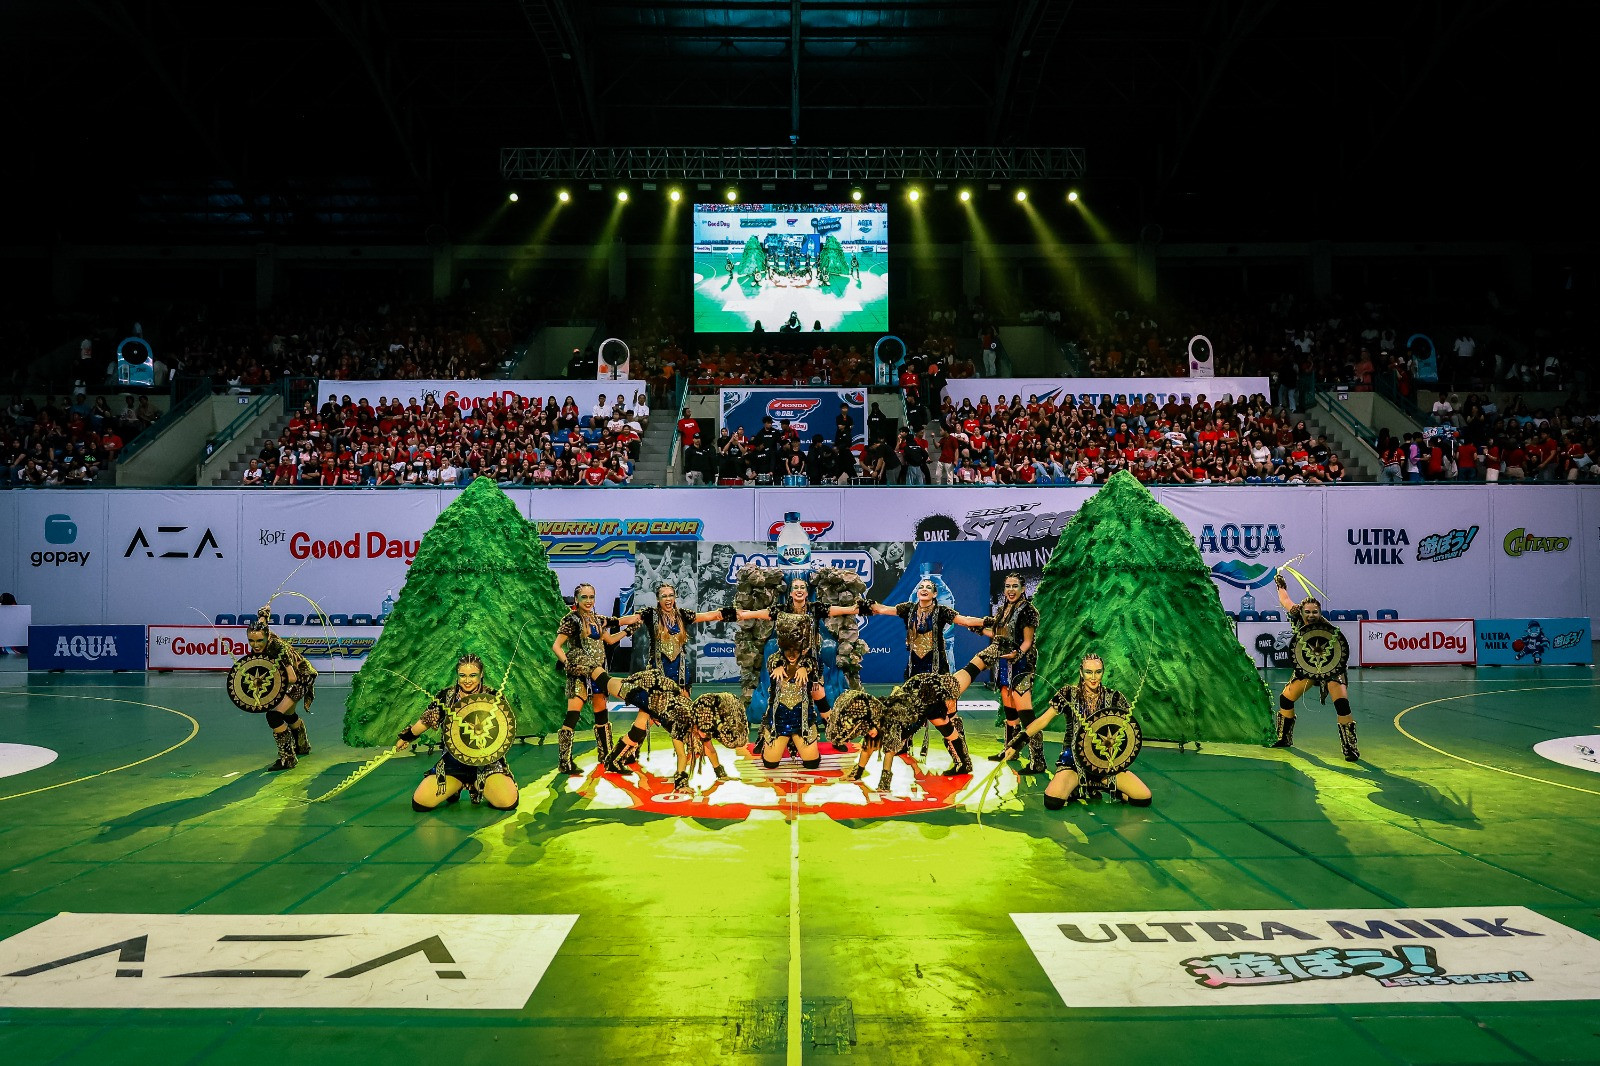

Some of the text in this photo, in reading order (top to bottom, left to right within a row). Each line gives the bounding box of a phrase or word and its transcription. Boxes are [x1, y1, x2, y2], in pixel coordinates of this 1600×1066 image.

[537, 521, 599, 535] WORTH
[627, 521, 649, 535] YA
[650, 521, 699, 535] CUMA
[923, 529, 950, 542] PAKE
[259, 529, 286, 545] Kopi
[290, 532, 361, 559] Good
[1200, 524, 1285, 559] AQUA
[1347, 528, 1410, 546] ULTRA
[30, 551, 91, 567] gopay
[784, 548, 805, 557] AQUA
[991, 550, 1032, 571] MAKIN
[1354, 548, 1405, 564] MILK
[1383, 632, 1430, 651] Good
[1432, 632, 1467, 654] Day
[1480, 632, 1511, 640] ULTRA
[54, 636, 118, 660] AQUA
[171, 637, 218, 655] Good
[1485, 642, 1509, 650] MILK
[1057, 918, 1546, 943] ULTRA MILK
[1377, 976, 1450, 987] LET'S
